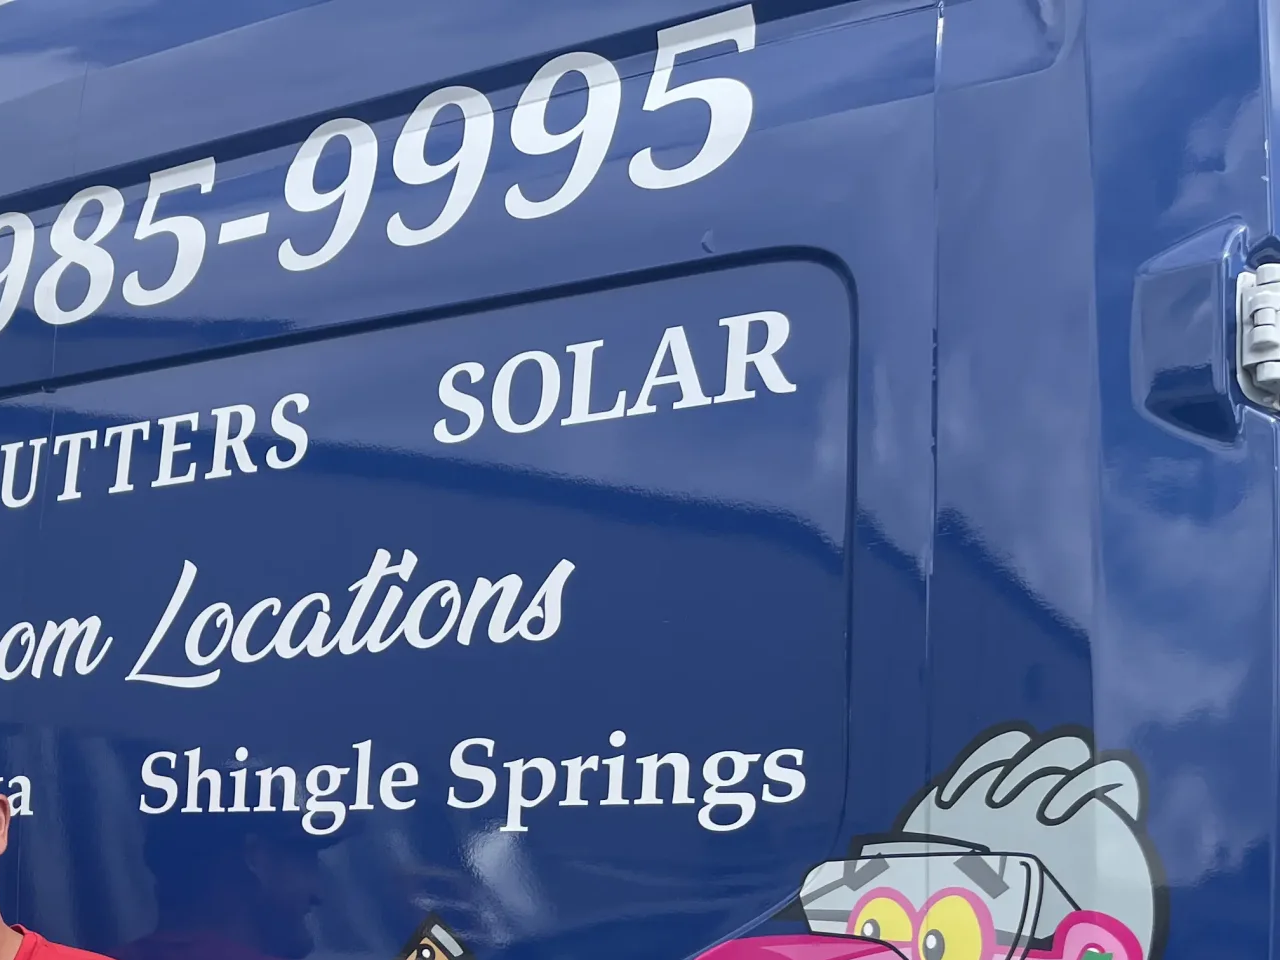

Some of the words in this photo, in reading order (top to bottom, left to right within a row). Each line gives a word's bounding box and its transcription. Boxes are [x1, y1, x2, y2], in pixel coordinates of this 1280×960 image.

[433, 310, 797, 444] SOLAR
[125, 548, 575, 688] Locations
[138, 740, 418, 835] Shingle
[447, 730, 806, 832] Springs
